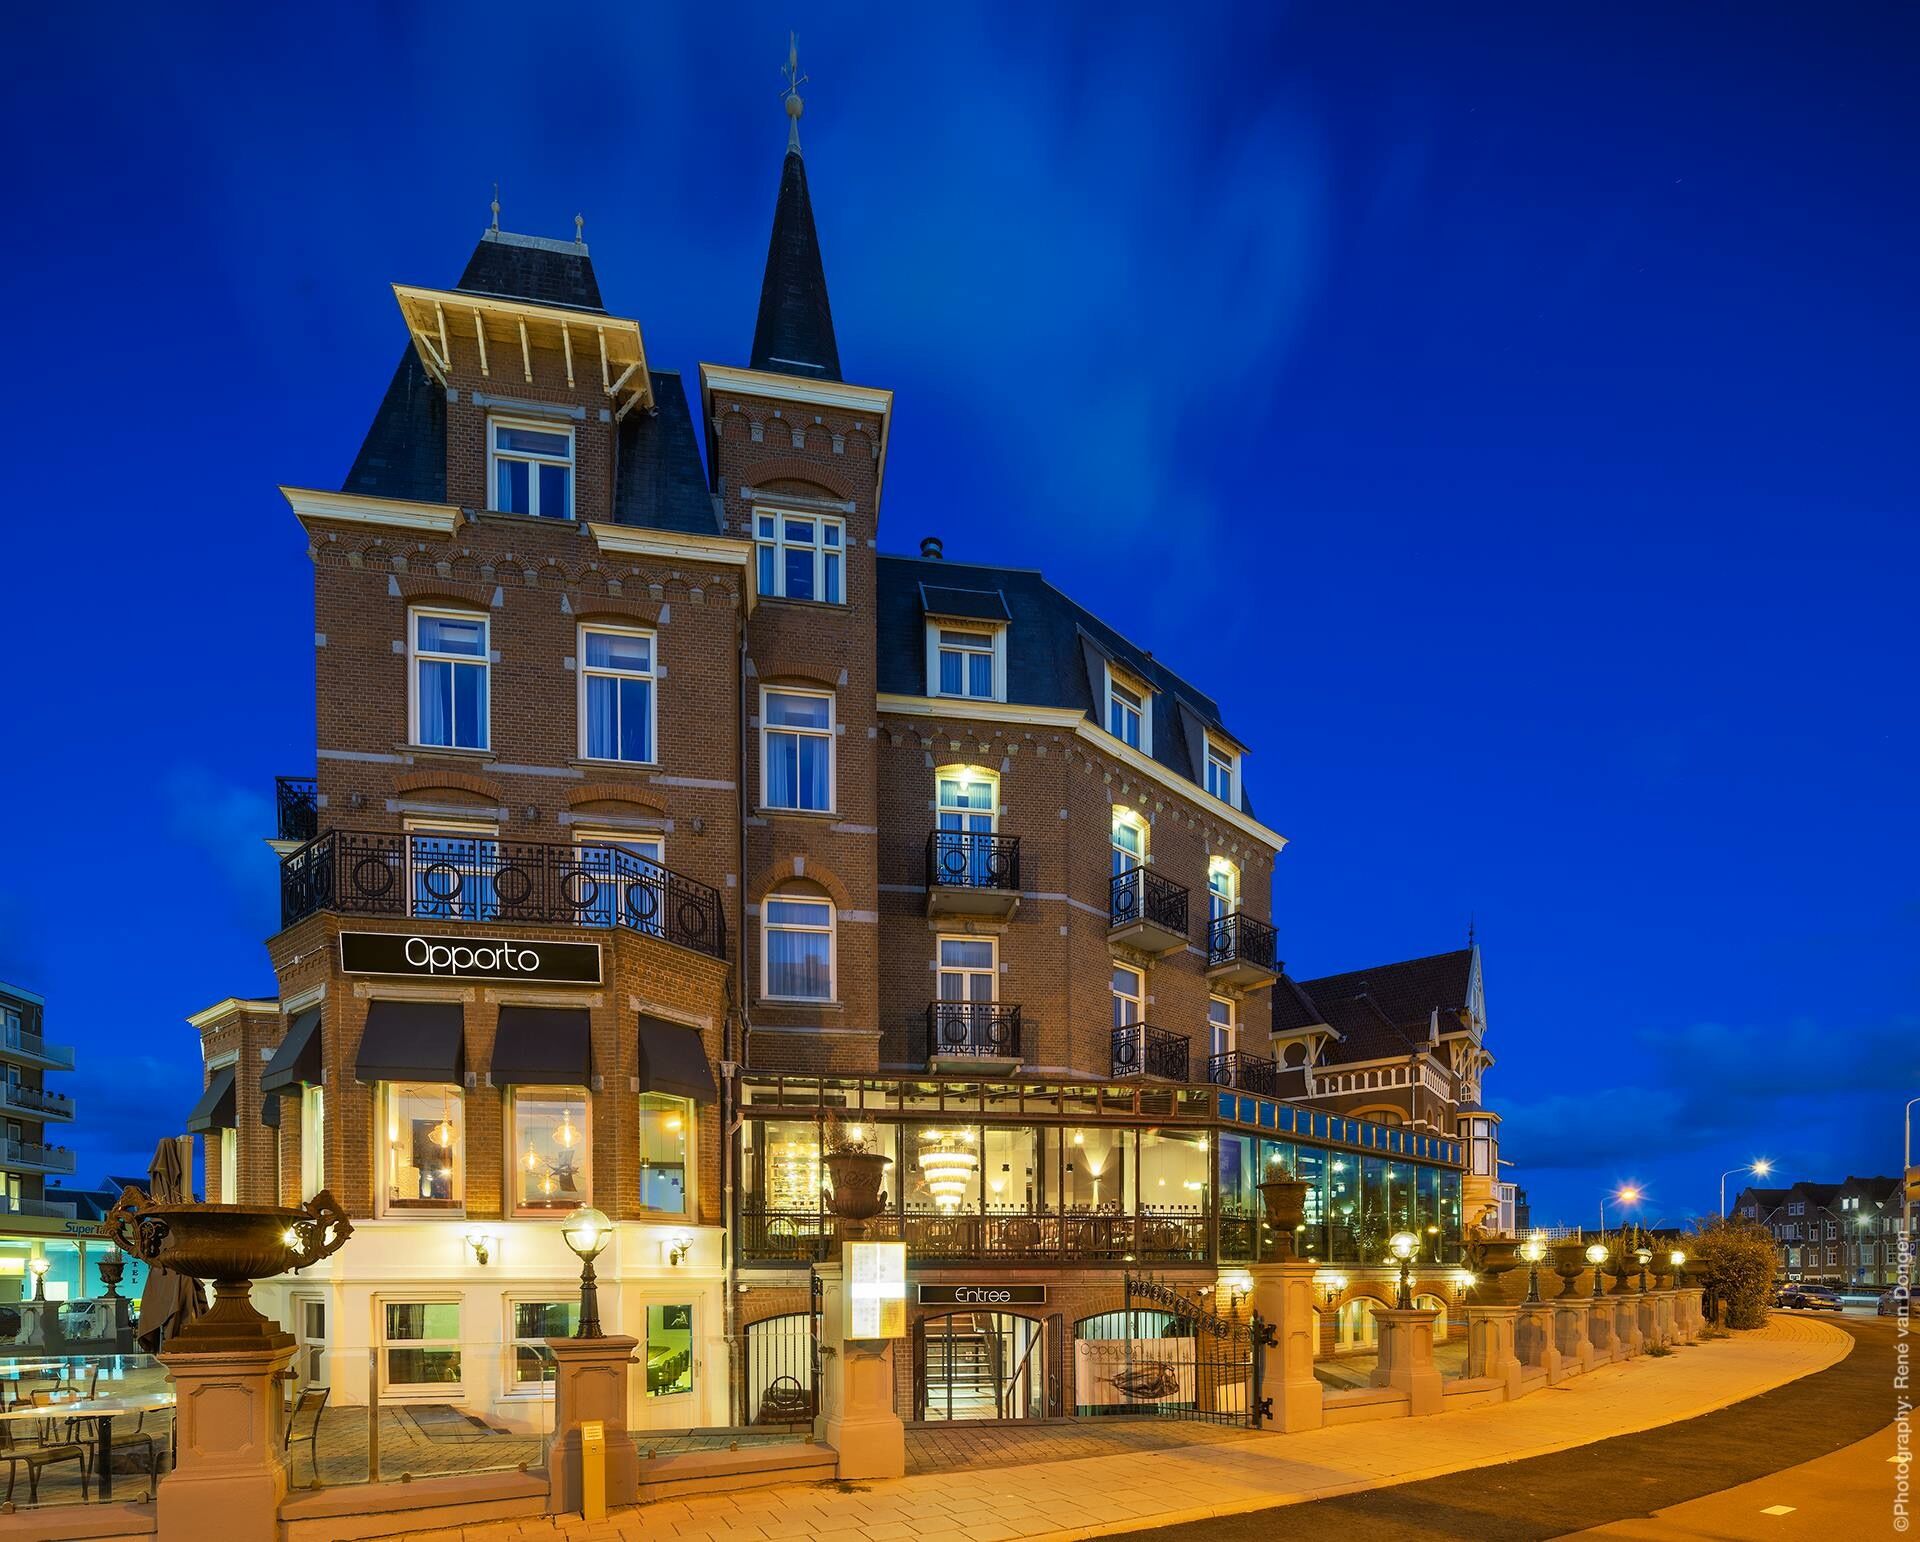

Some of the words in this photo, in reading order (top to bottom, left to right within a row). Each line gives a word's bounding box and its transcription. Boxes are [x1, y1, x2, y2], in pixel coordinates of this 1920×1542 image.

[405, 937, 540, 975] Opporto
[60, 1221, 108, 1238] SuperTa
[955, 1286, 1011, 1303] Entree
